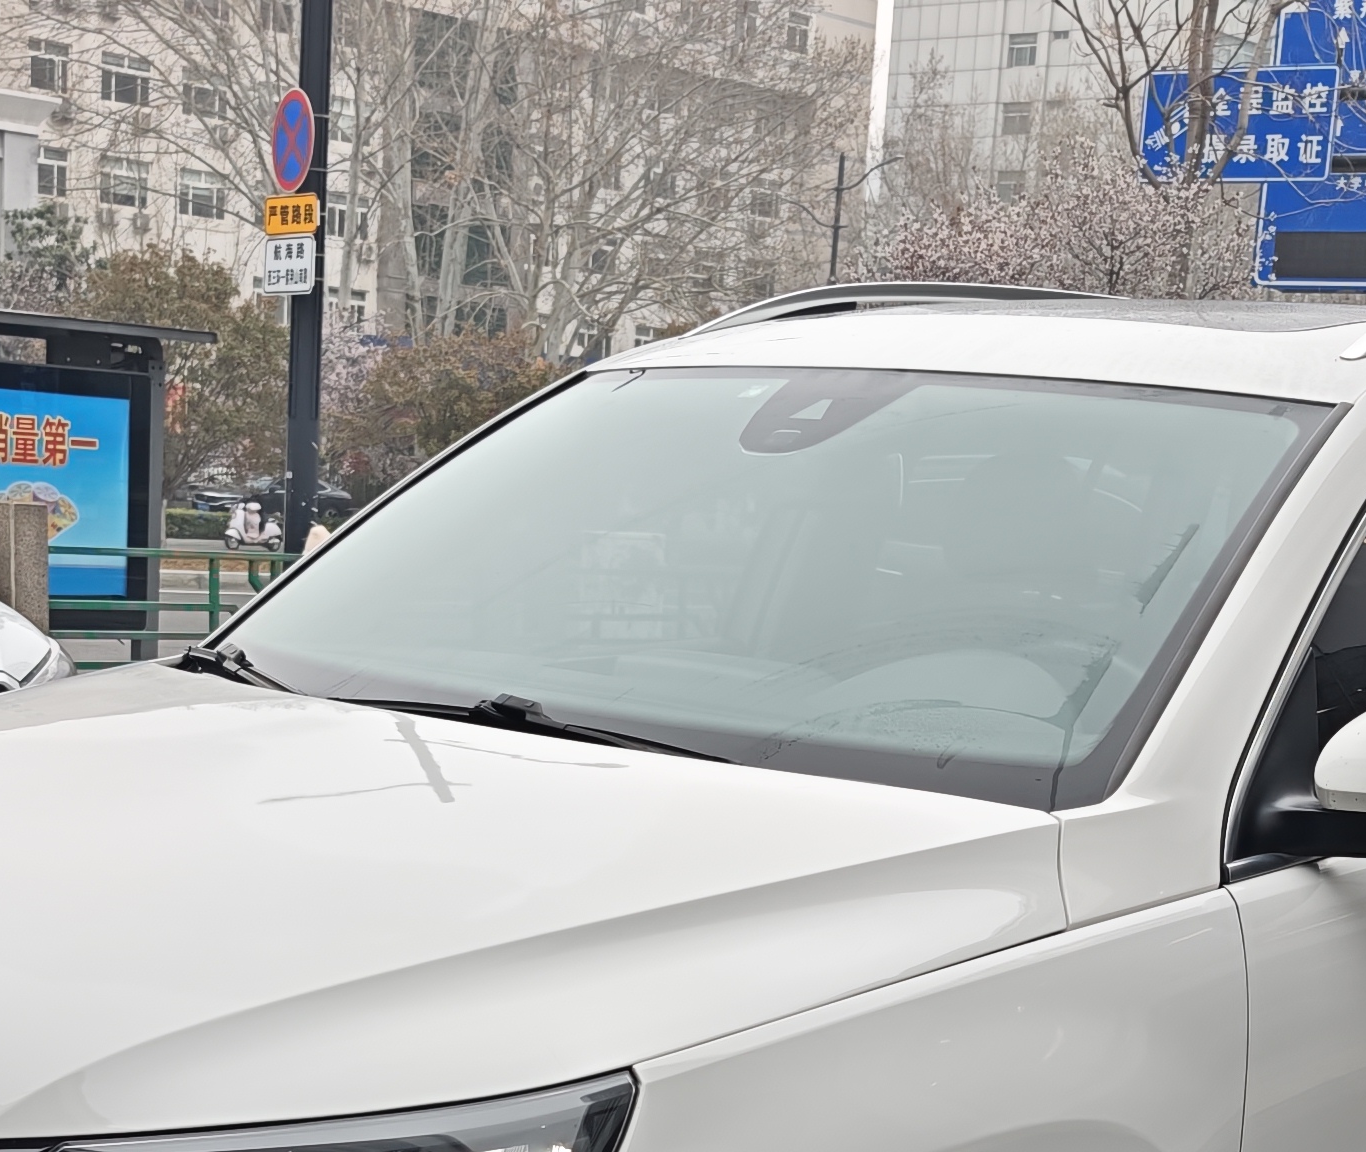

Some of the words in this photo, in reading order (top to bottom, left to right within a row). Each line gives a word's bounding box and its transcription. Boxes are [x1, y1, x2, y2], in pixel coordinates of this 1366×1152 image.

[1210, 82, 1330, 117] 全程监控
[1202, 134, 1324, 165] 摄录取证
[268, 204, 315, 226] 严管路段
